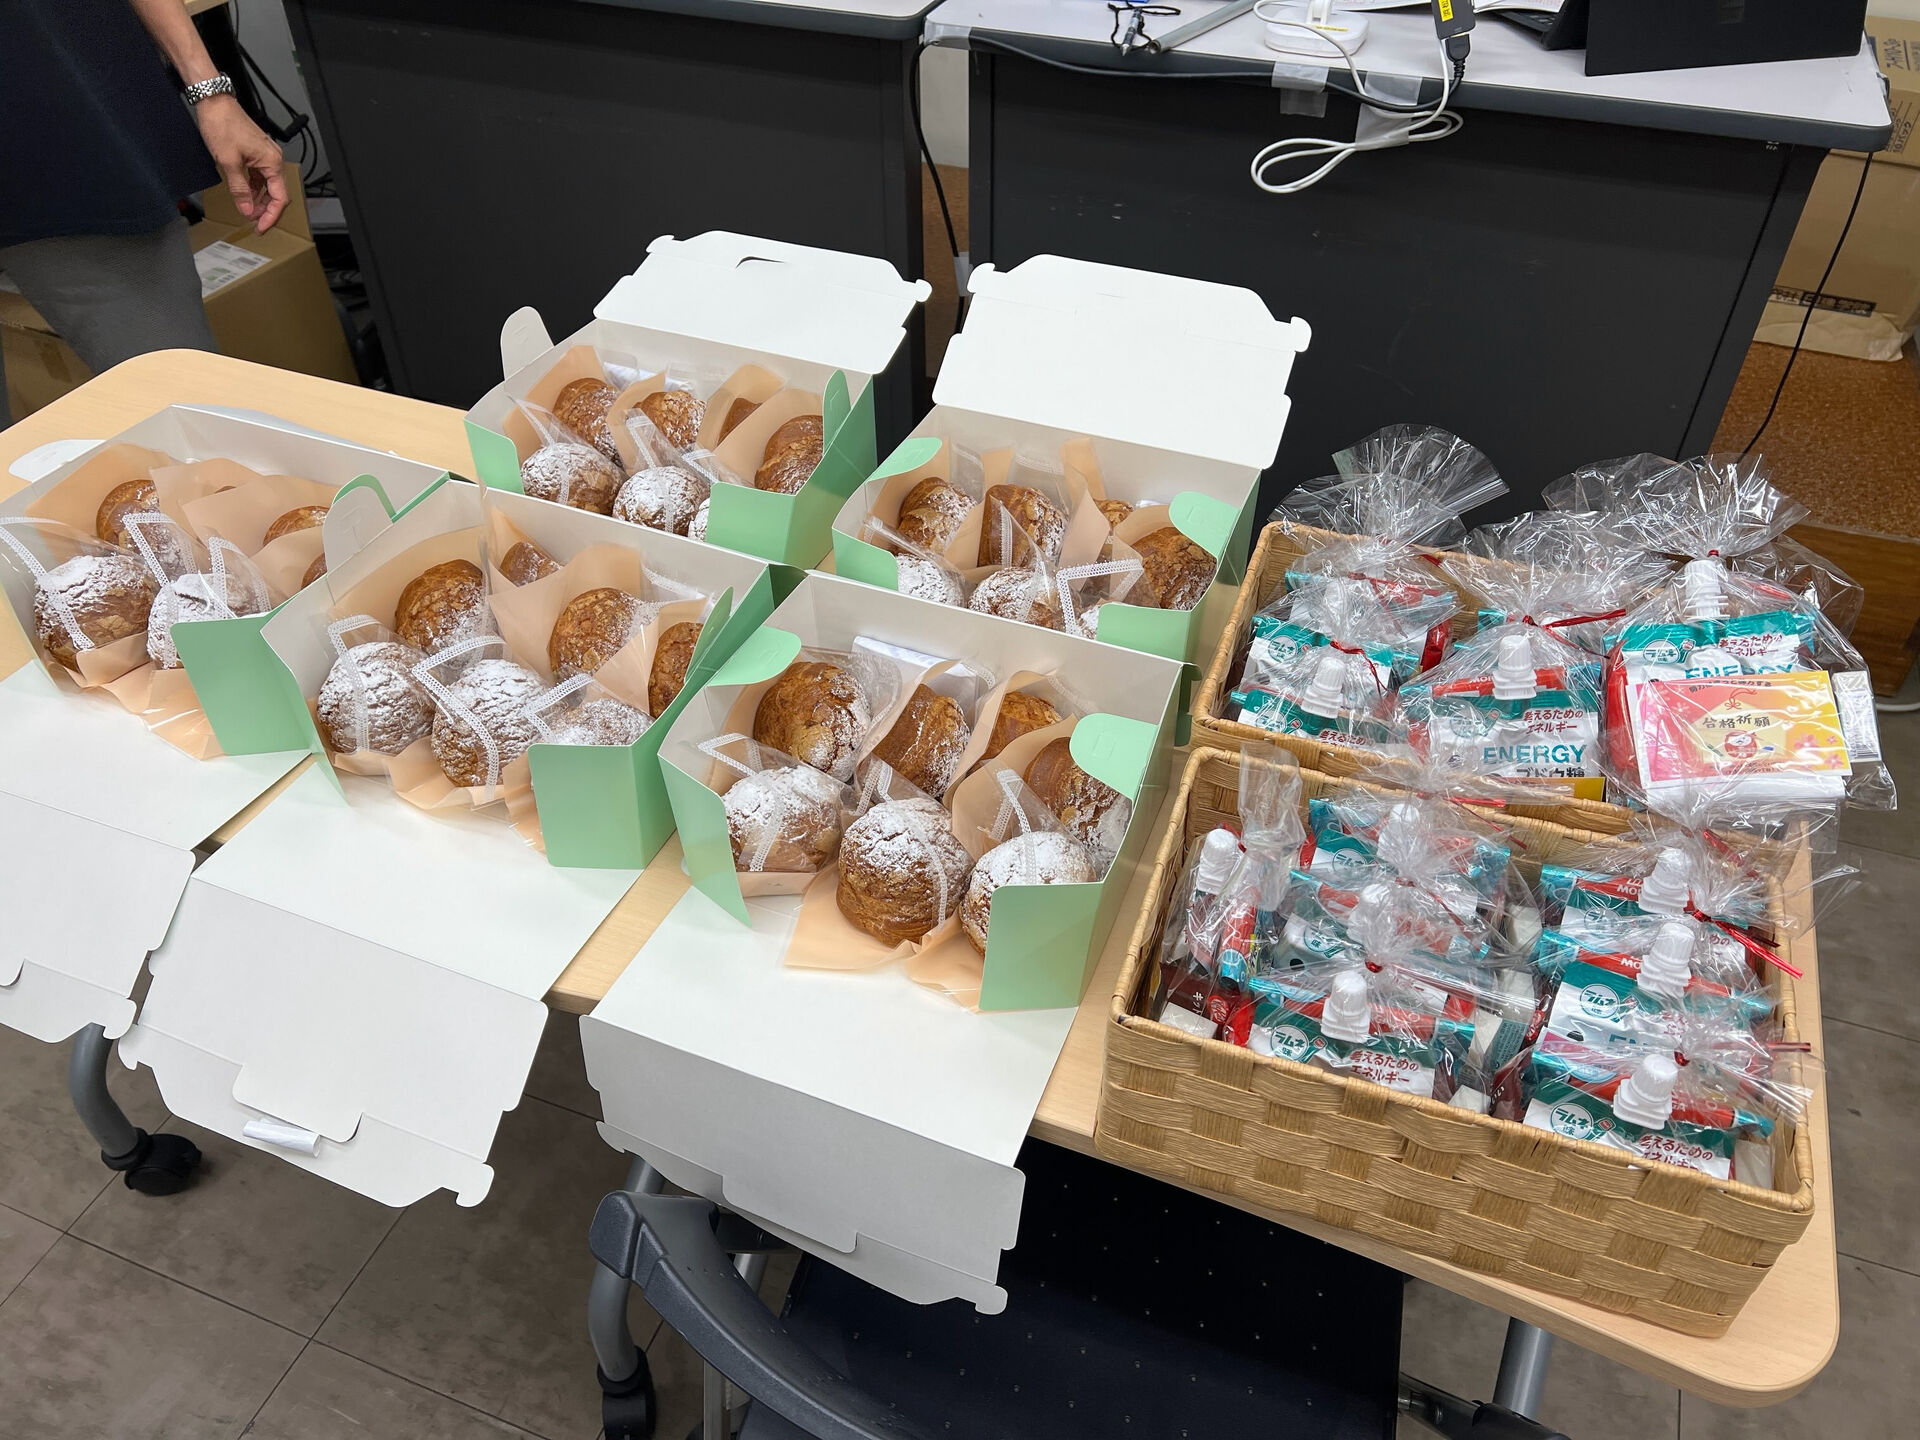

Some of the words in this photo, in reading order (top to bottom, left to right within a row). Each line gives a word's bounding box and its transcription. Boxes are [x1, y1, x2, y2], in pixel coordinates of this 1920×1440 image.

[1523, 708, 1583, 722] 考えるための
[1702, 713, 1771, 729] 合格祈願
[1527, 723, 1578, 734] エネルギー
[1483, 744, 1587, 764] ENERGY
[1275, 1031, 1306, 1048] ラムネ
[1350, 1050, 1419, 1071] 考えるための
[1351, 1064, 1410, 1084] エネルギー
[1555, 1108, 1591, 1129] ラムネ
[1640, 1134, 1713, 1161] 考えるための
